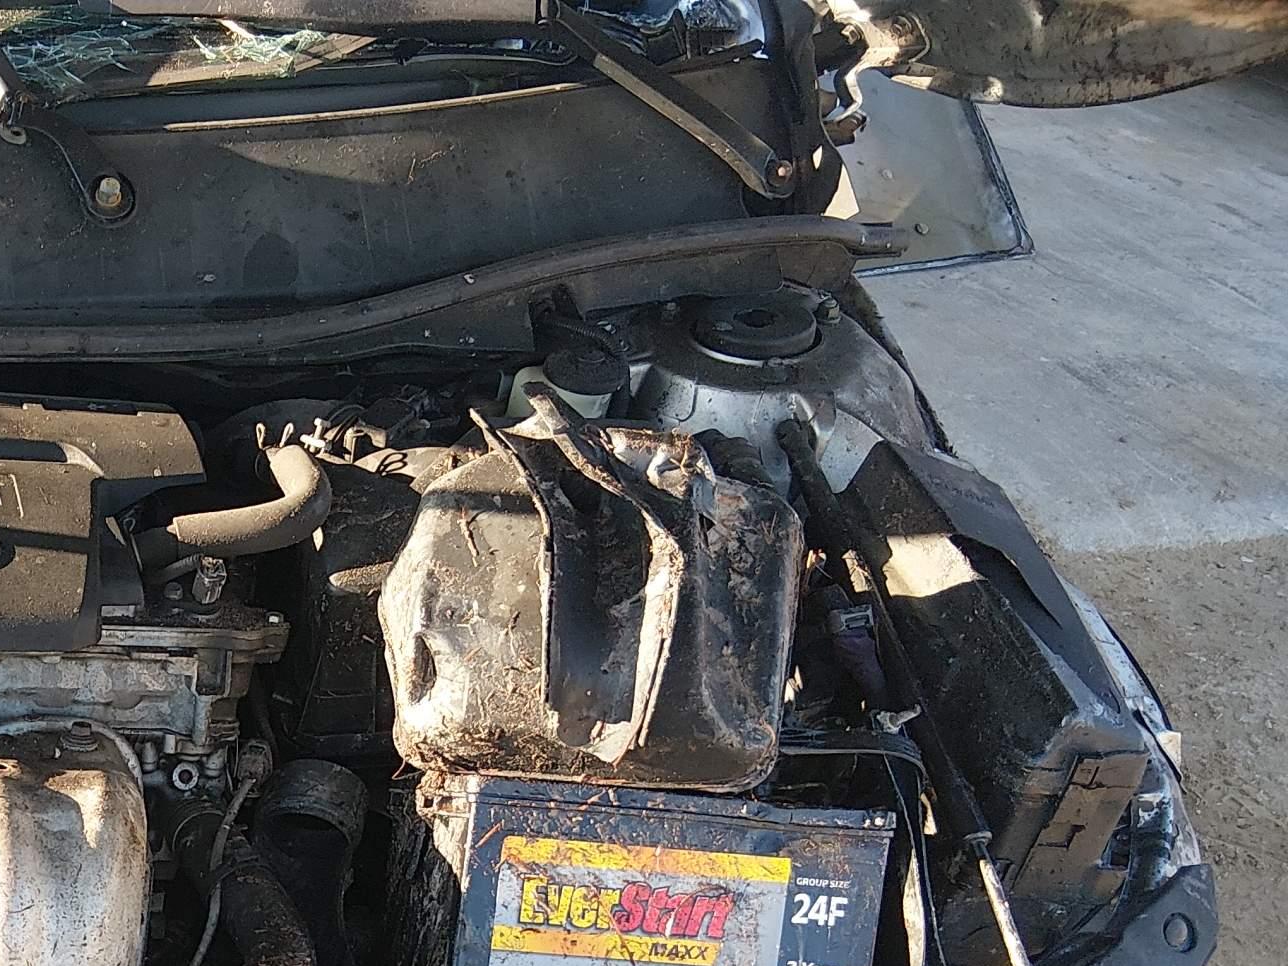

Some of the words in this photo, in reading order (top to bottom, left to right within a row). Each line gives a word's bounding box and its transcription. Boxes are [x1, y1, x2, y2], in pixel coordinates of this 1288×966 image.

[796, 877, 828, 887] GROUP
[830, 880, 850, 888] SIZE
[519, 876, 733, 938] EverStart
[791, 893, 848, 926] 24F
[648, 942, 709, 960] MAXX
